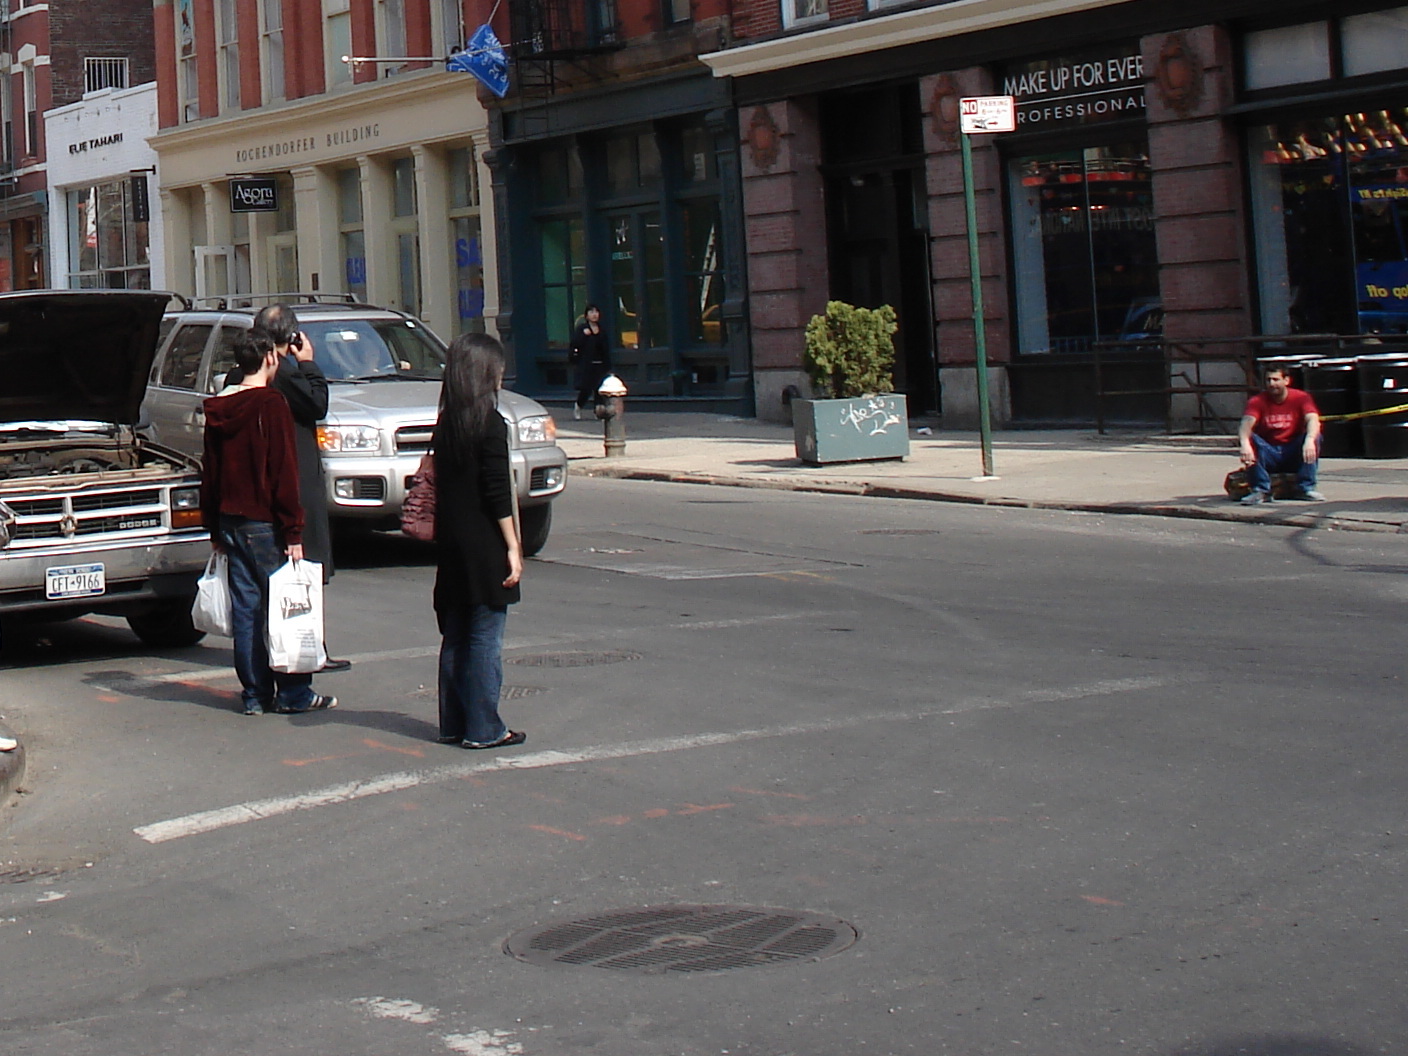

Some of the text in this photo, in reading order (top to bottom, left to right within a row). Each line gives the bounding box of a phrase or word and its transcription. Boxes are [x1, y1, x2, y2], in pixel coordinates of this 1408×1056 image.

[1003, 70, 1047, 96] MAKE
[1050, 67, 1070, 92] UP
[1073, 61, 1104, 88] FOR
[962, 101, 977, 114] NO
[1017, 97, 1147, 125] ROFESSIONAL
[89, 132, 123, 151] TAHARI
[236, 123, 381, 163] KOCHENDORFER BUILDING
[235, 184, 273, 204] Agora
